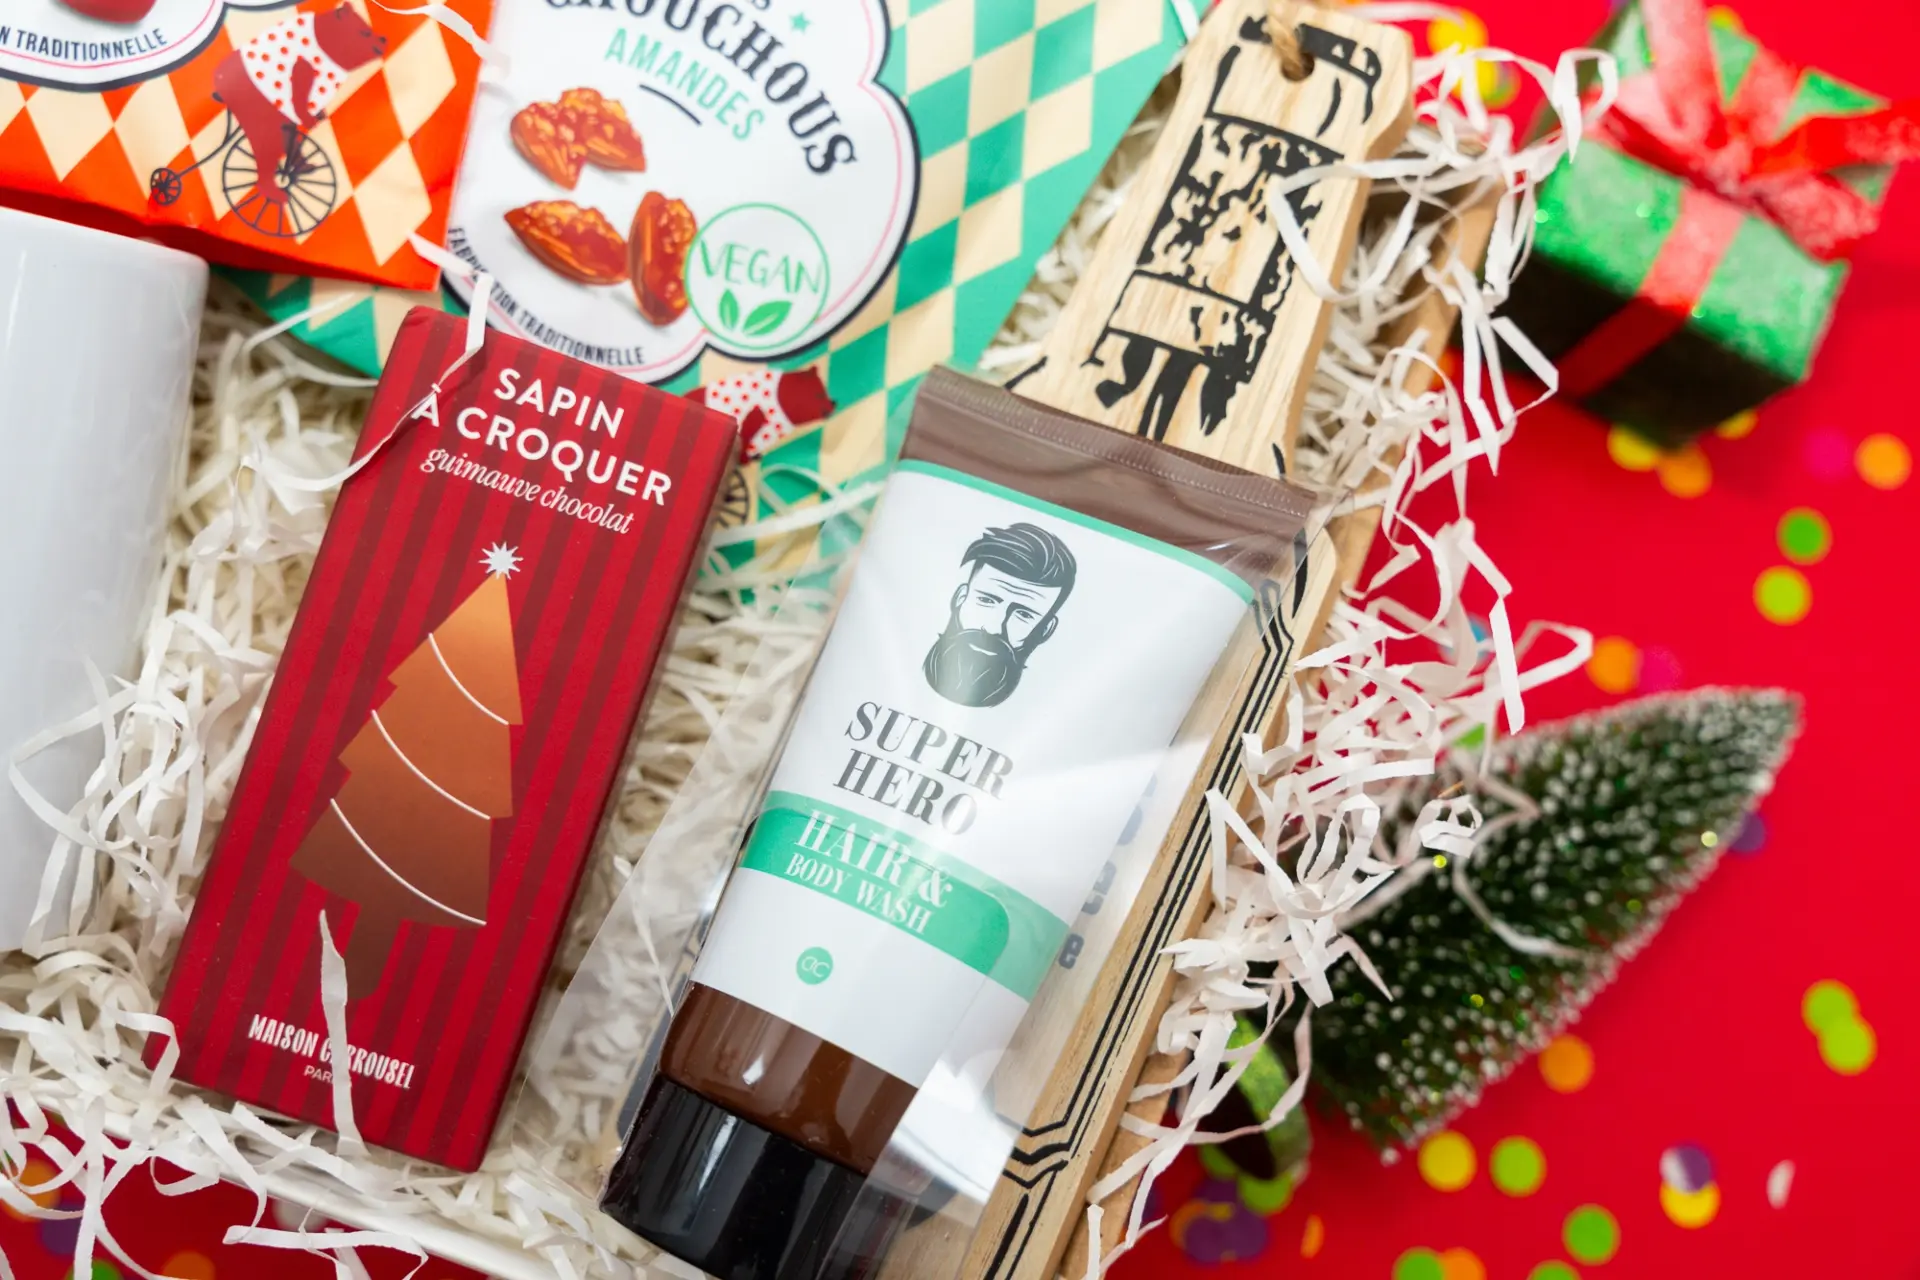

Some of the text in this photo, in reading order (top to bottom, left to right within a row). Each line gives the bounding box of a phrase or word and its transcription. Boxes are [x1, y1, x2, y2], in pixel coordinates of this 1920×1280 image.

[16, 28, 168, 61] TRADITIONNELLE
[604, 28, 765, 142] AMANDES
[700, 238, 821, 294] VEGAN
[518, 311, 645, 366] TRADITIONNELLE
[411, 382, 672, 506] À CROQUER
[494, 368, 625, 439] SAPIN
[420, 448, 635, 534] guimauve chocolat
[833, 748, 978, 835] HERO
[844, 701, 1014, 799] SUPER
[784, 852, 933, 935] BODY WASH
[794, 809, 953, 908] HAIR &
[248, 1013, 415, 1090] MAISON CRROUSEL
